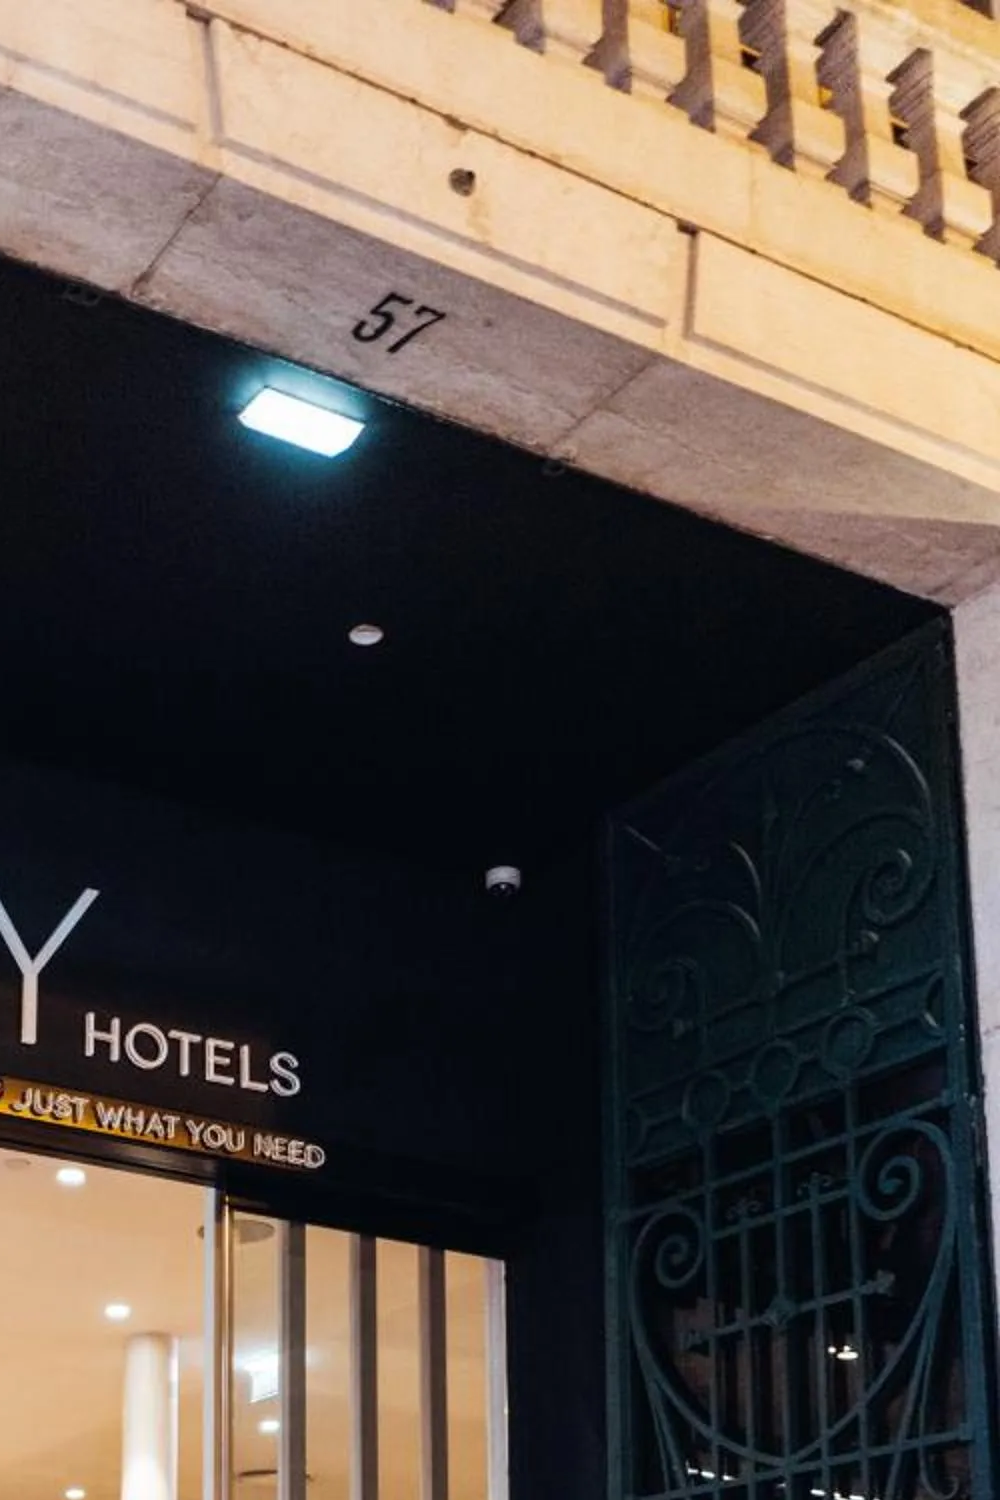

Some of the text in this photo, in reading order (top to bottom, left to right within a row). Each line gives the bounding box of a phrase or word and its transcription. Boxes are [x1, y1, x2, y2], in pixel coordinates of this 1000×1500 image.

[352, 292, 446, 353] 57
[85, 1011, 301, 1096] HOTELS
[13, 1087, 326, 1169] JUST WHAT YOU NEED
